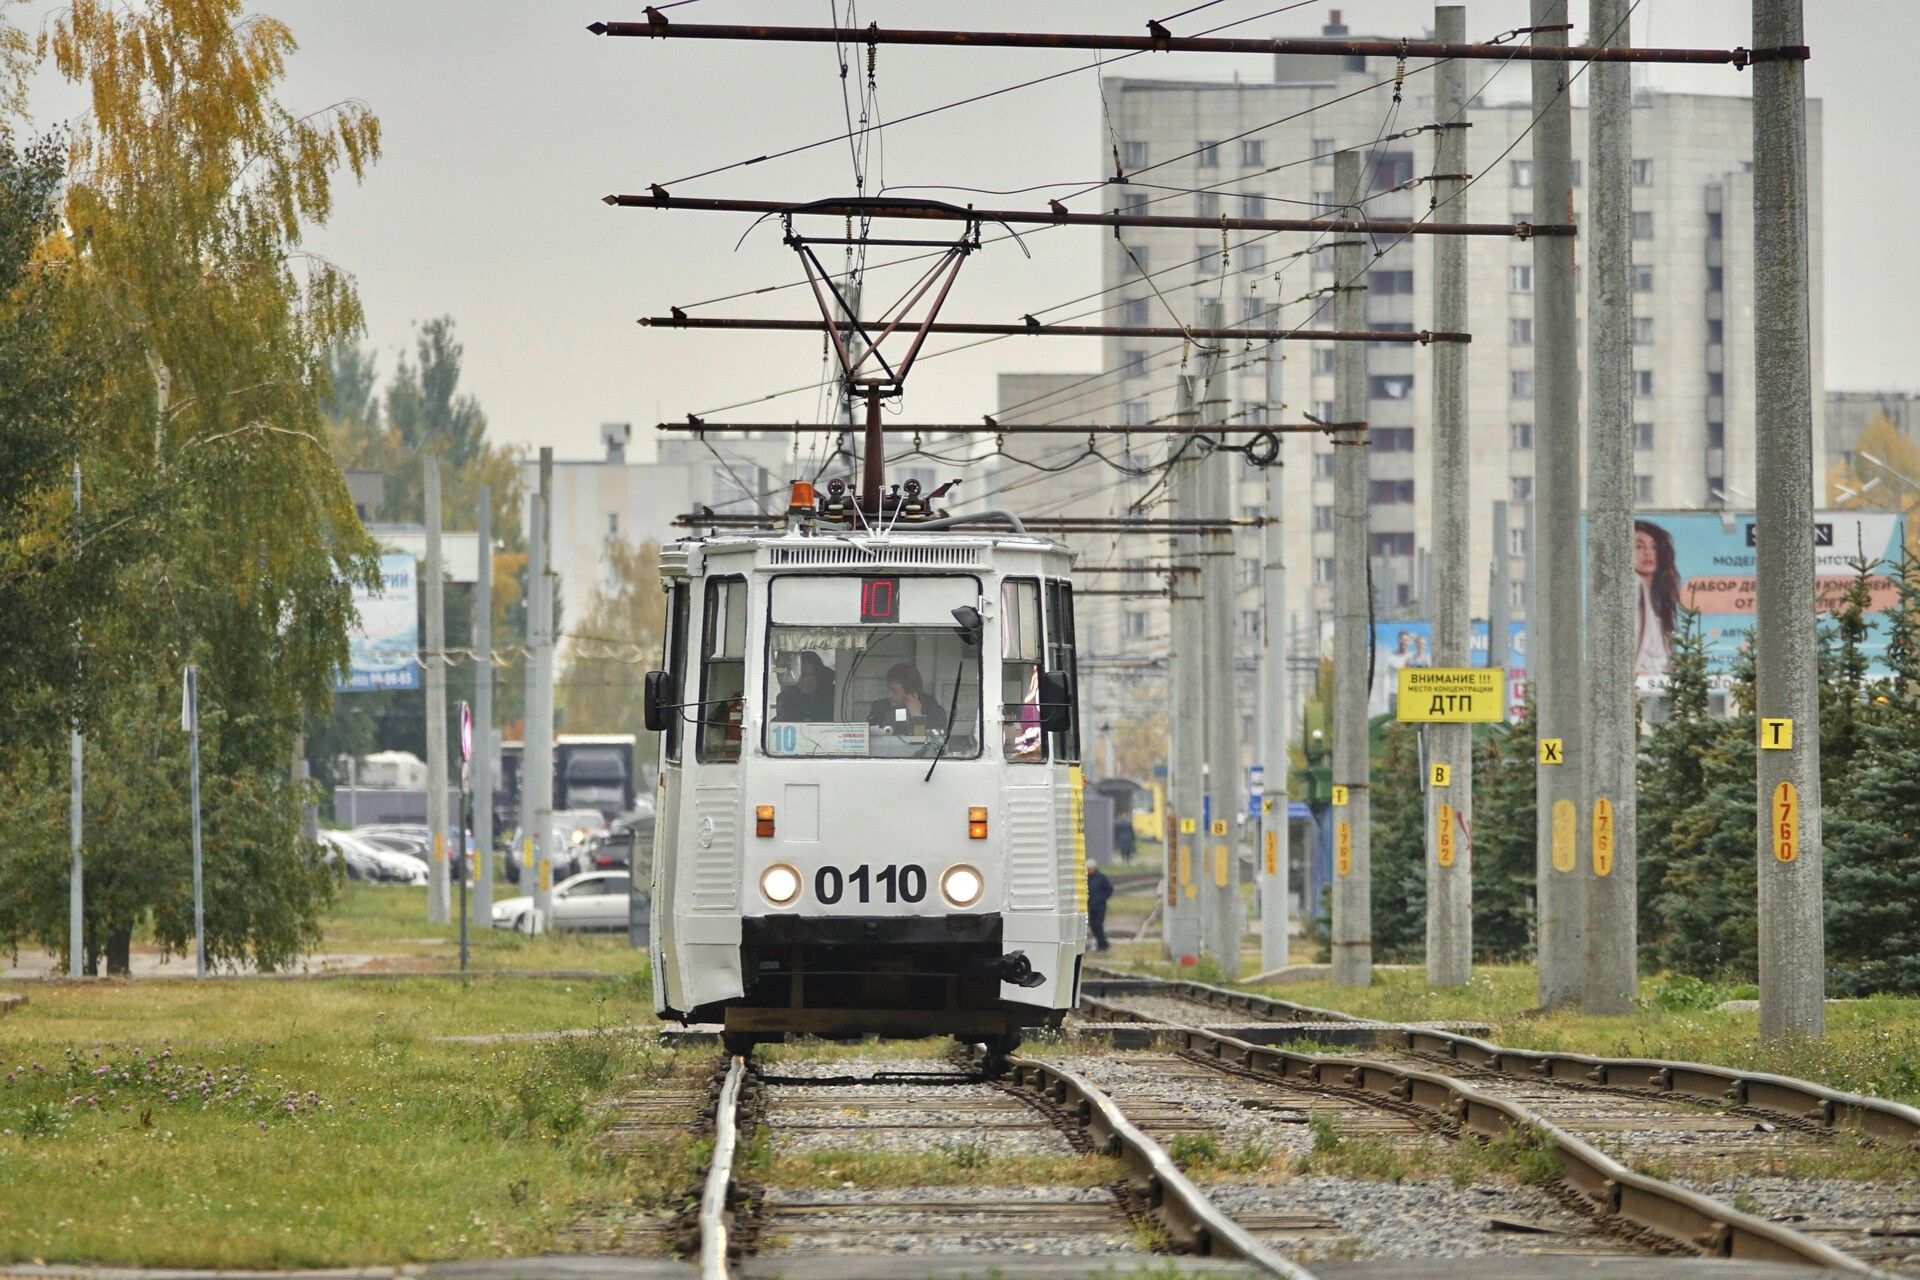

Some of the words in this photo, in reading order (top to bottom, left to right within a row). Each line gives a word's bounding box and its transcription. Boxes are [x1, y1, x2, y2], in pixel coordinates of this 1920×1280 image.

[861, 580, 893, 617] 10
[1687, 580, 1737, 592] НАБОР
[1408, 685, 1432, 693] МЕСТО
[1433, 685, 1493, 694] КОНЦЕНТРАЦИИ
[1410, 673, 1476, 684] ВНИМАНИЕ
[1429, 694, 1472, 715] ДТП
[772, 724, 797, 752] 10
[1440, 805, 1450, 862] 1762
[1598, 800, 1609, 871] 1761
[1779, 783, 1792, 861] 1760
[815, 864, 927, 905] 0110
